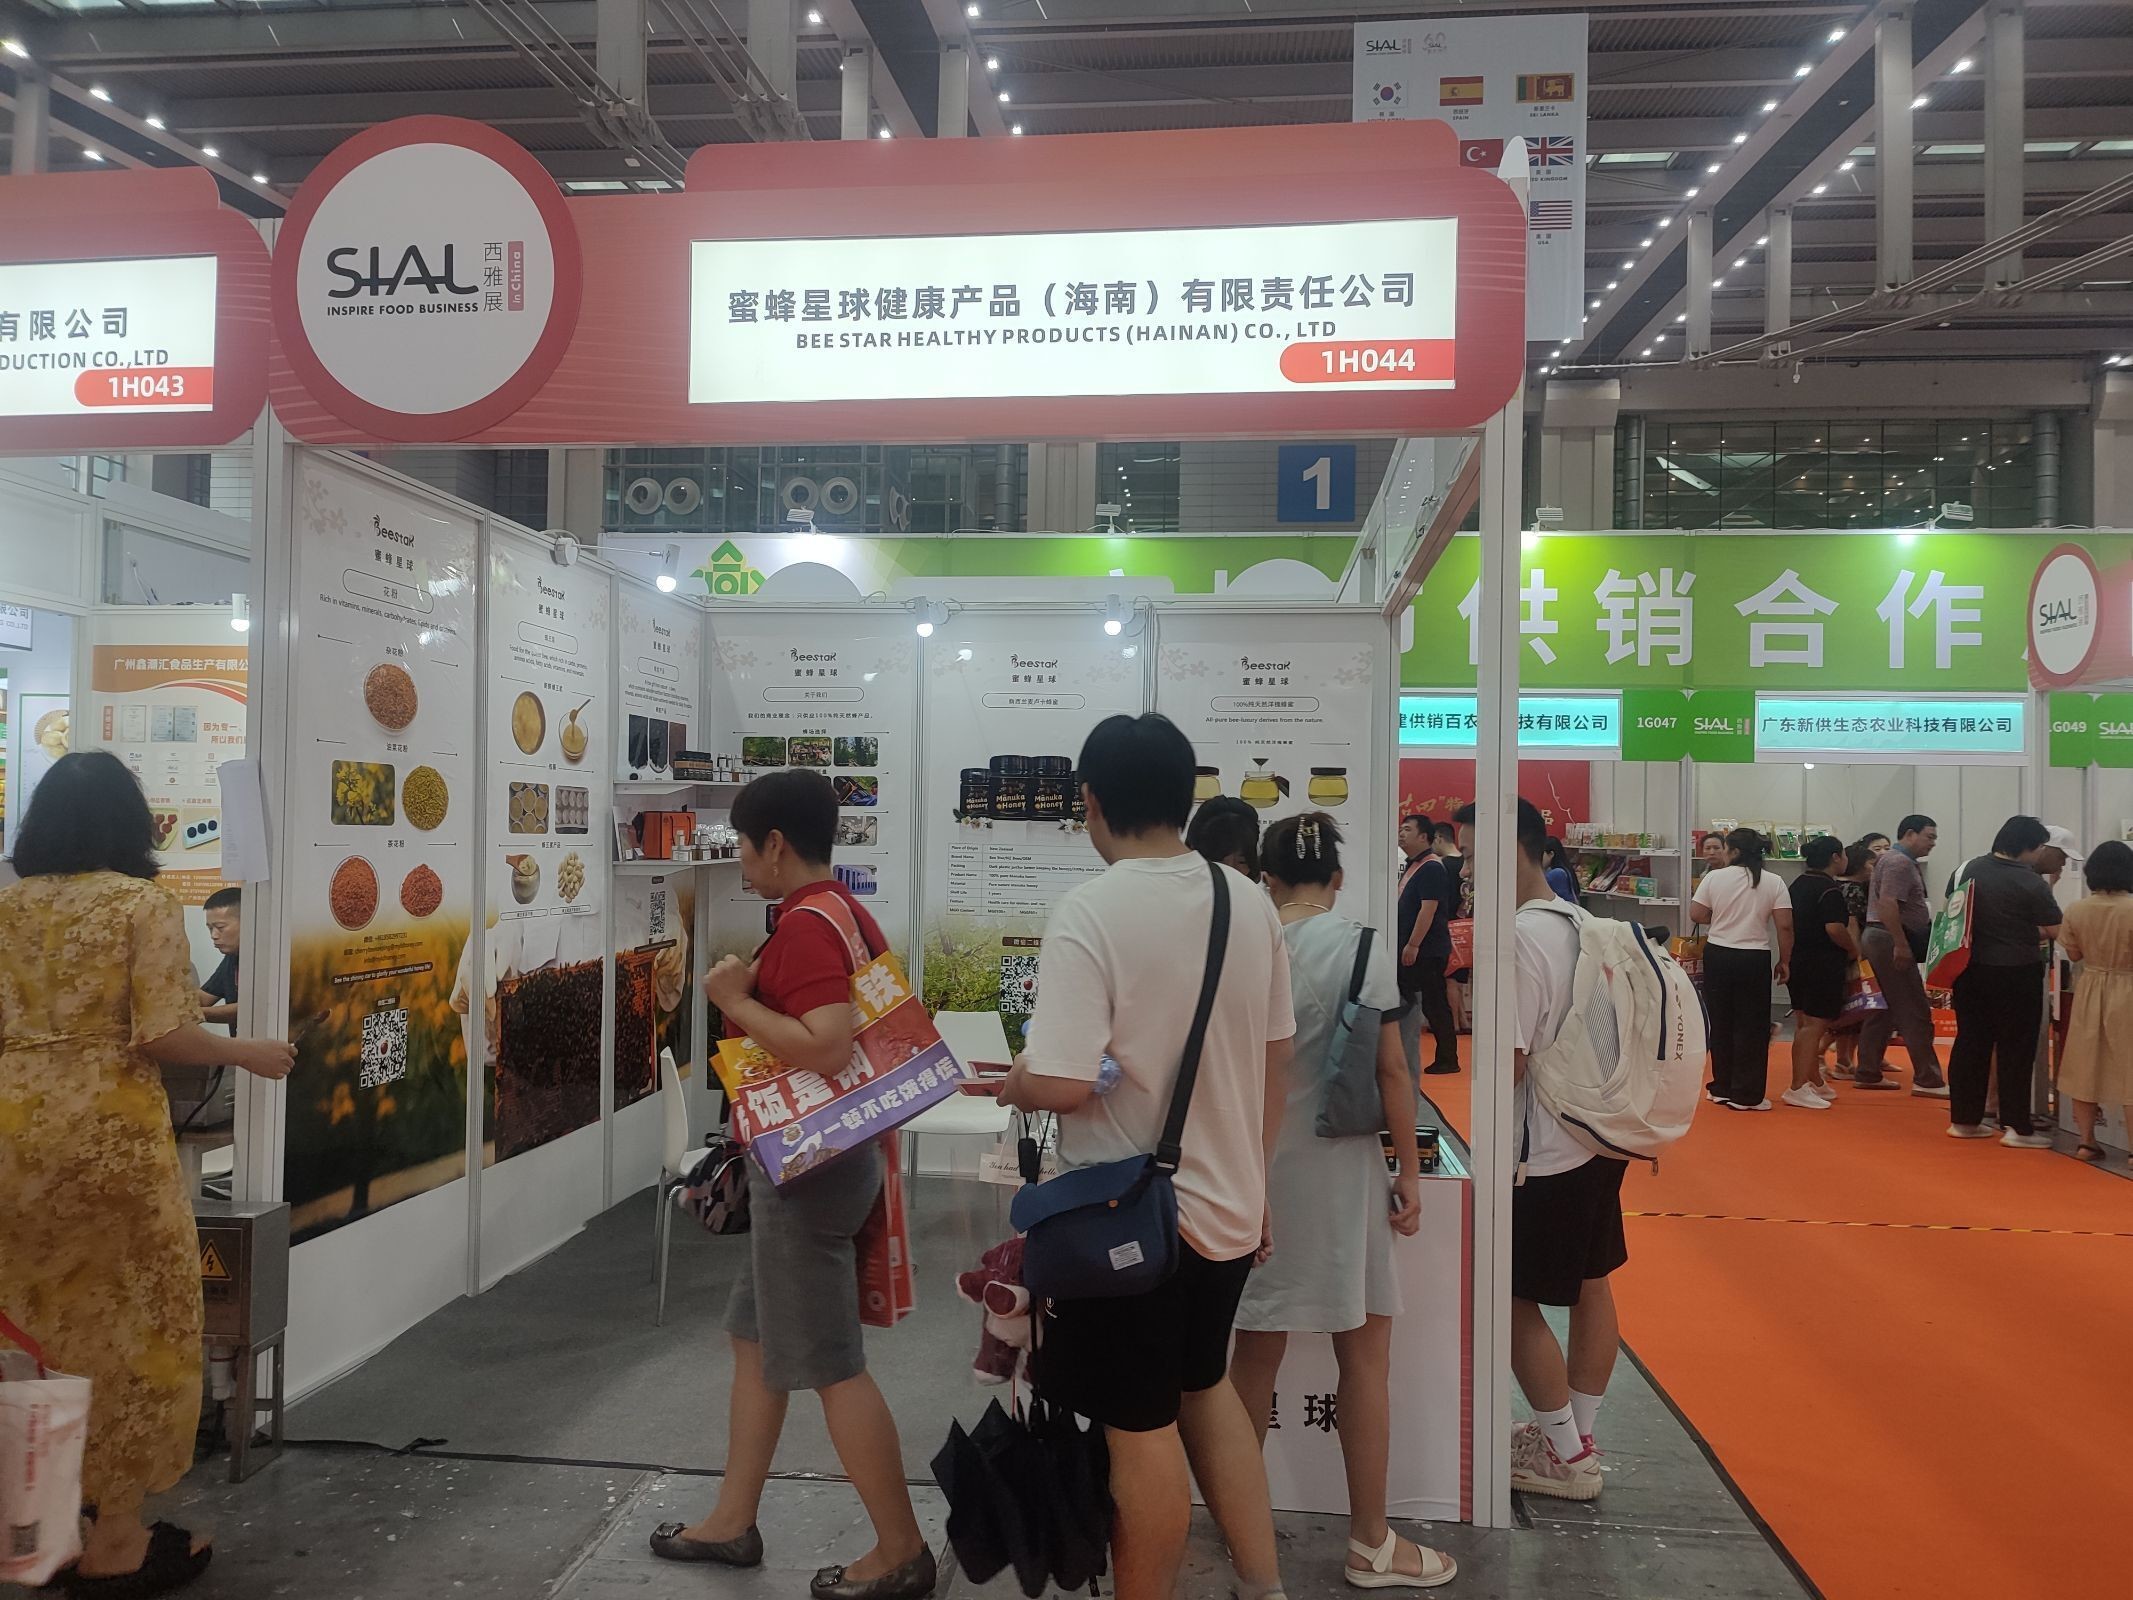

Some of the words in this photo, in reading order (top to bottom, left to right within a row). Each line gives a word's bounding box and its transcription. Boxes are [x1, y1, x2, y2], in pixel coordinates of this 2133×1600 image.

[1366, 40, 1401, 52] SIAL
[326, 243, 479, 299] SIAL
[482, 241, 505, 312] 西雅展
[511, 250, 521, 292] China
[327, 305, 375, 316] INSPIRE
[379, 304, 414, 315] FOOD
[419, 302, 479, 314] BUSINESS
[0, 306, 128, 342] 有限公司
[796, 333, 834, 349] BEE
[839, 331, 893, 349] STAR
[896, 328, 998, 348] HEALTHY
[1002, 325, 1122, 347] PRODUCTS
[1126, 322, 1239, 346] (HAINAN)
[1321, 348, 1415, 374] 1H044
[107, 376, 185, 399] 1H043
[1300, 457, 1337, 511] 1
[374, 549, 415, 572] 蜜蜂星球
[320, 593, 332, 603] Rich
[1400, 568, 2028, 671] 供销合作
[2039, 598, 2078, 627] SIAL
[794, 668, 838, 677] 蜜蜂星球
[1011, 674, 1057, 684] 蜜蜂星球
[1242, 677, 1289, 686] 蜜蜂星球
[804, 691, 829, 699] 关于我们
[1636, 717, 1678, 729] 1G047
[1693, 717, 1734, 731] SIAL
[1762, 716, 2013, 733] 广东新供生态农业科技有限公司
[2049, 721, 2087, 733] G049
[211, 735, 246, 745] 所以我们
[1002, 801, 1027, 811] Honey
[1040, 801, 1064, 810] Honey
[1673, 1013, 1685, 1062] YONEX
[823, 1055, 959, 1136] 一顿不吃饿得慌
